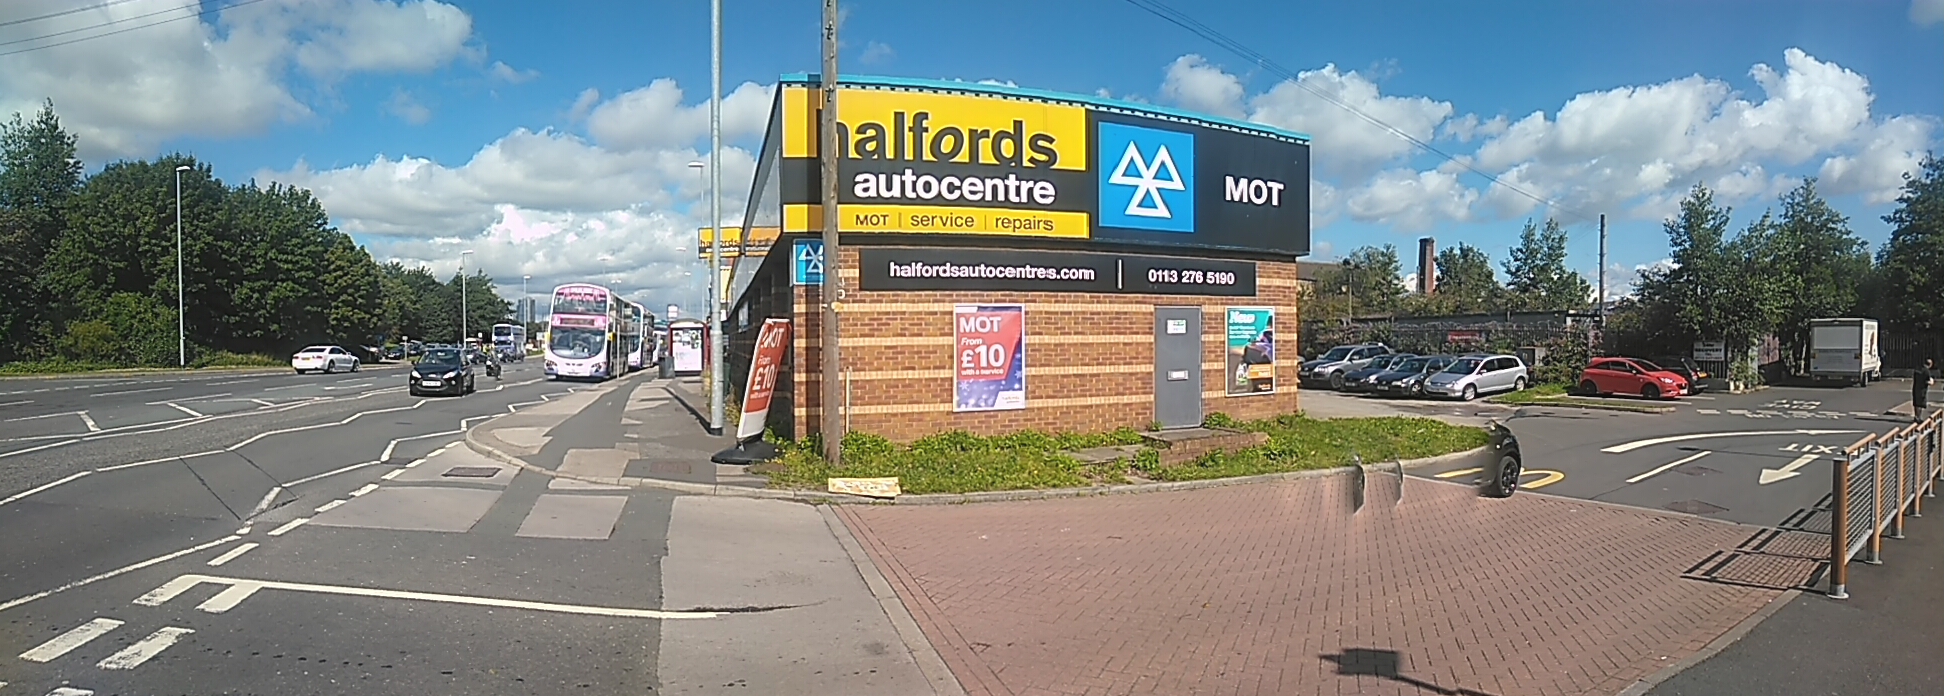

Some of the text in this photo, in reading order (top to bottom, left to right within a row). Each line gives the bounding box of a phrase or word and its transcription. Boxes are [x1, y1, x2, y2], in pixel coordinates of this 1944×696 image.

[817, 109, 1058, 168] halfords
[853, 168, 1056, 205] autocentre
[1224, 175, 1285, 206] MOT
[855, 212, 1054, 232] MOT service repairs
[889, 261, 1095, 280] halfordsautocentres.com
[1148, 269, 1235, 285] 0113 276 5190
[959, 316, 1002, 333] MOT
[760, 327, 785, 348] MOT
[960, 337, 983, 346] From
[961, 343, 1006, 368] £10
[752, 363, 776, 390] £10
